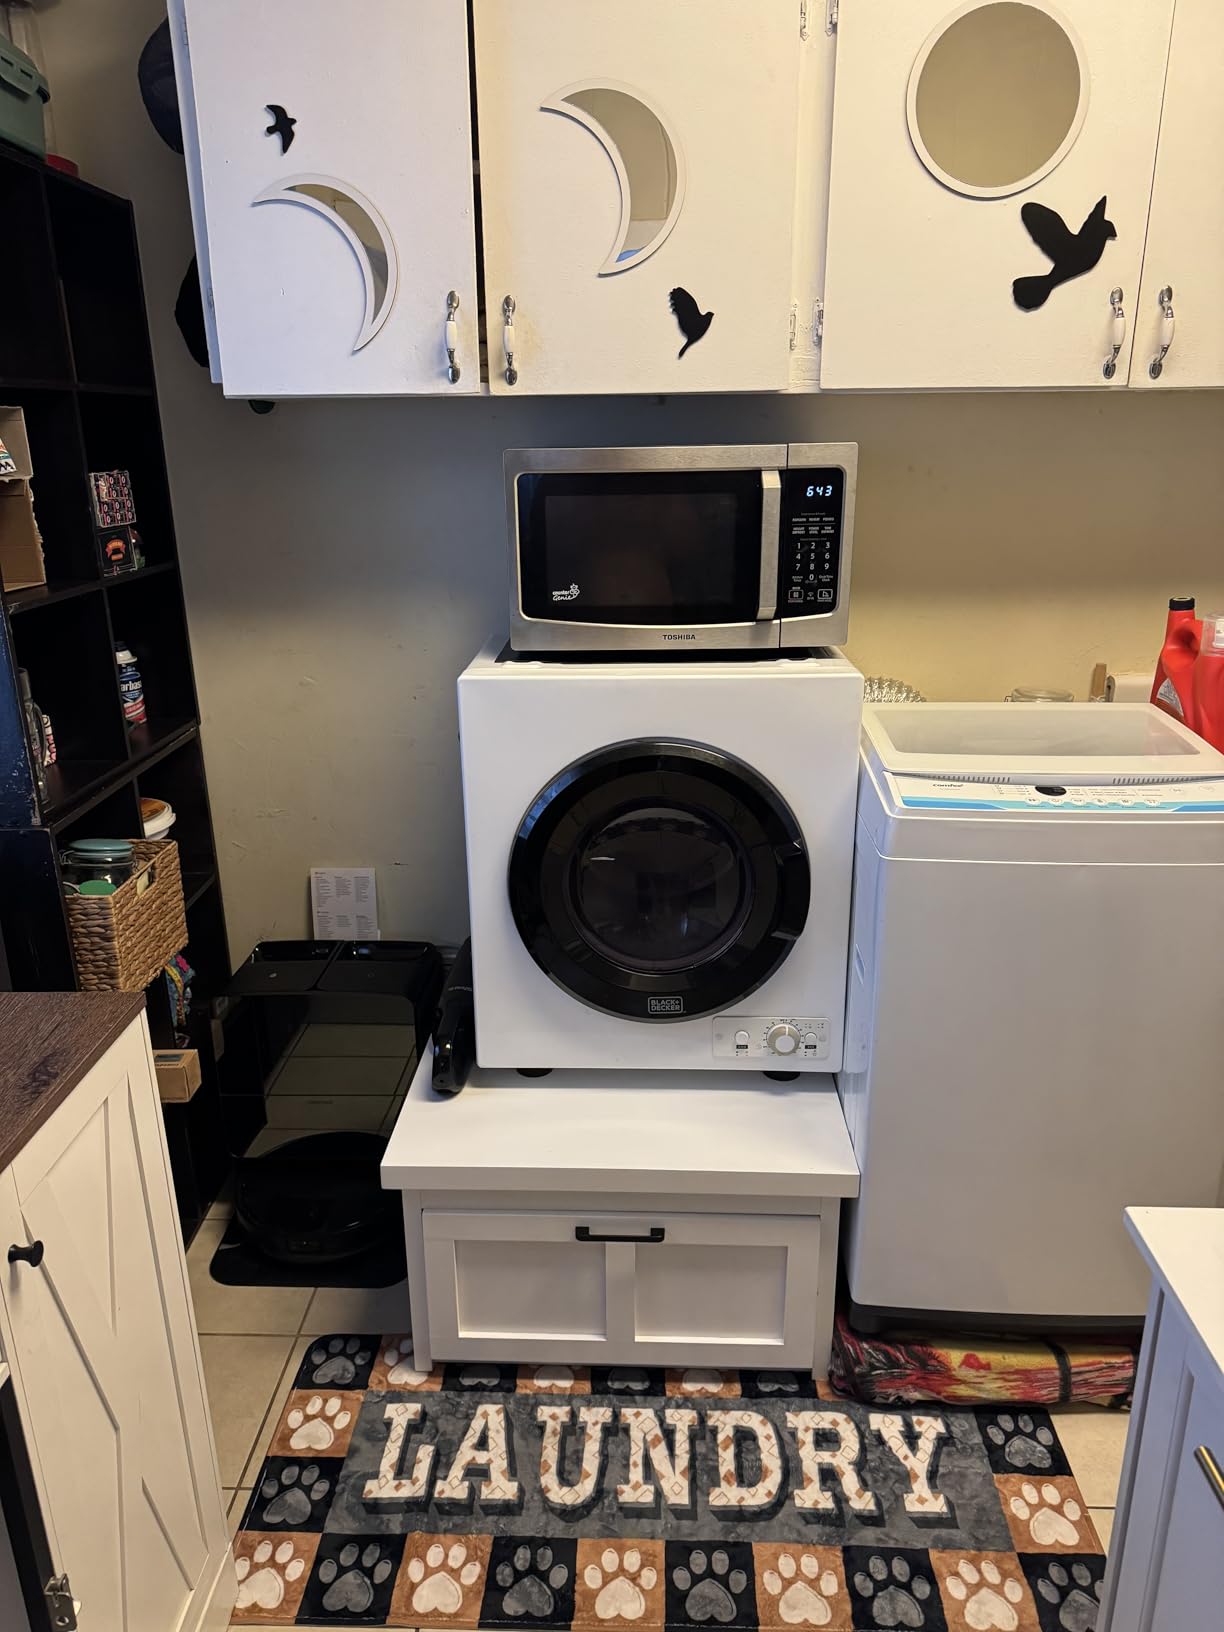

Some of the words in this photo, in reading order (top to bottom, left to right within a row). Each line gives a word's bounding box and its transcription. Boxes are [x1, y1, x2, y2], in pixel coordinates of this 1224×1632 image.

[810, 542, 816, 550] 2
[825, 541, 830, 549] 3
[810, 552, 816, 560] 5
[824, 552, 830, 560] 6
[795, 563, 801, 571] 7
[809, 563, 815, 571] 8
[824, 562, 830, 570] 9
[808, 573, 815, 581] 0
[120, 680, 142, 692] arbas
[362, 1402, 947, 1516] LAUNDRY
